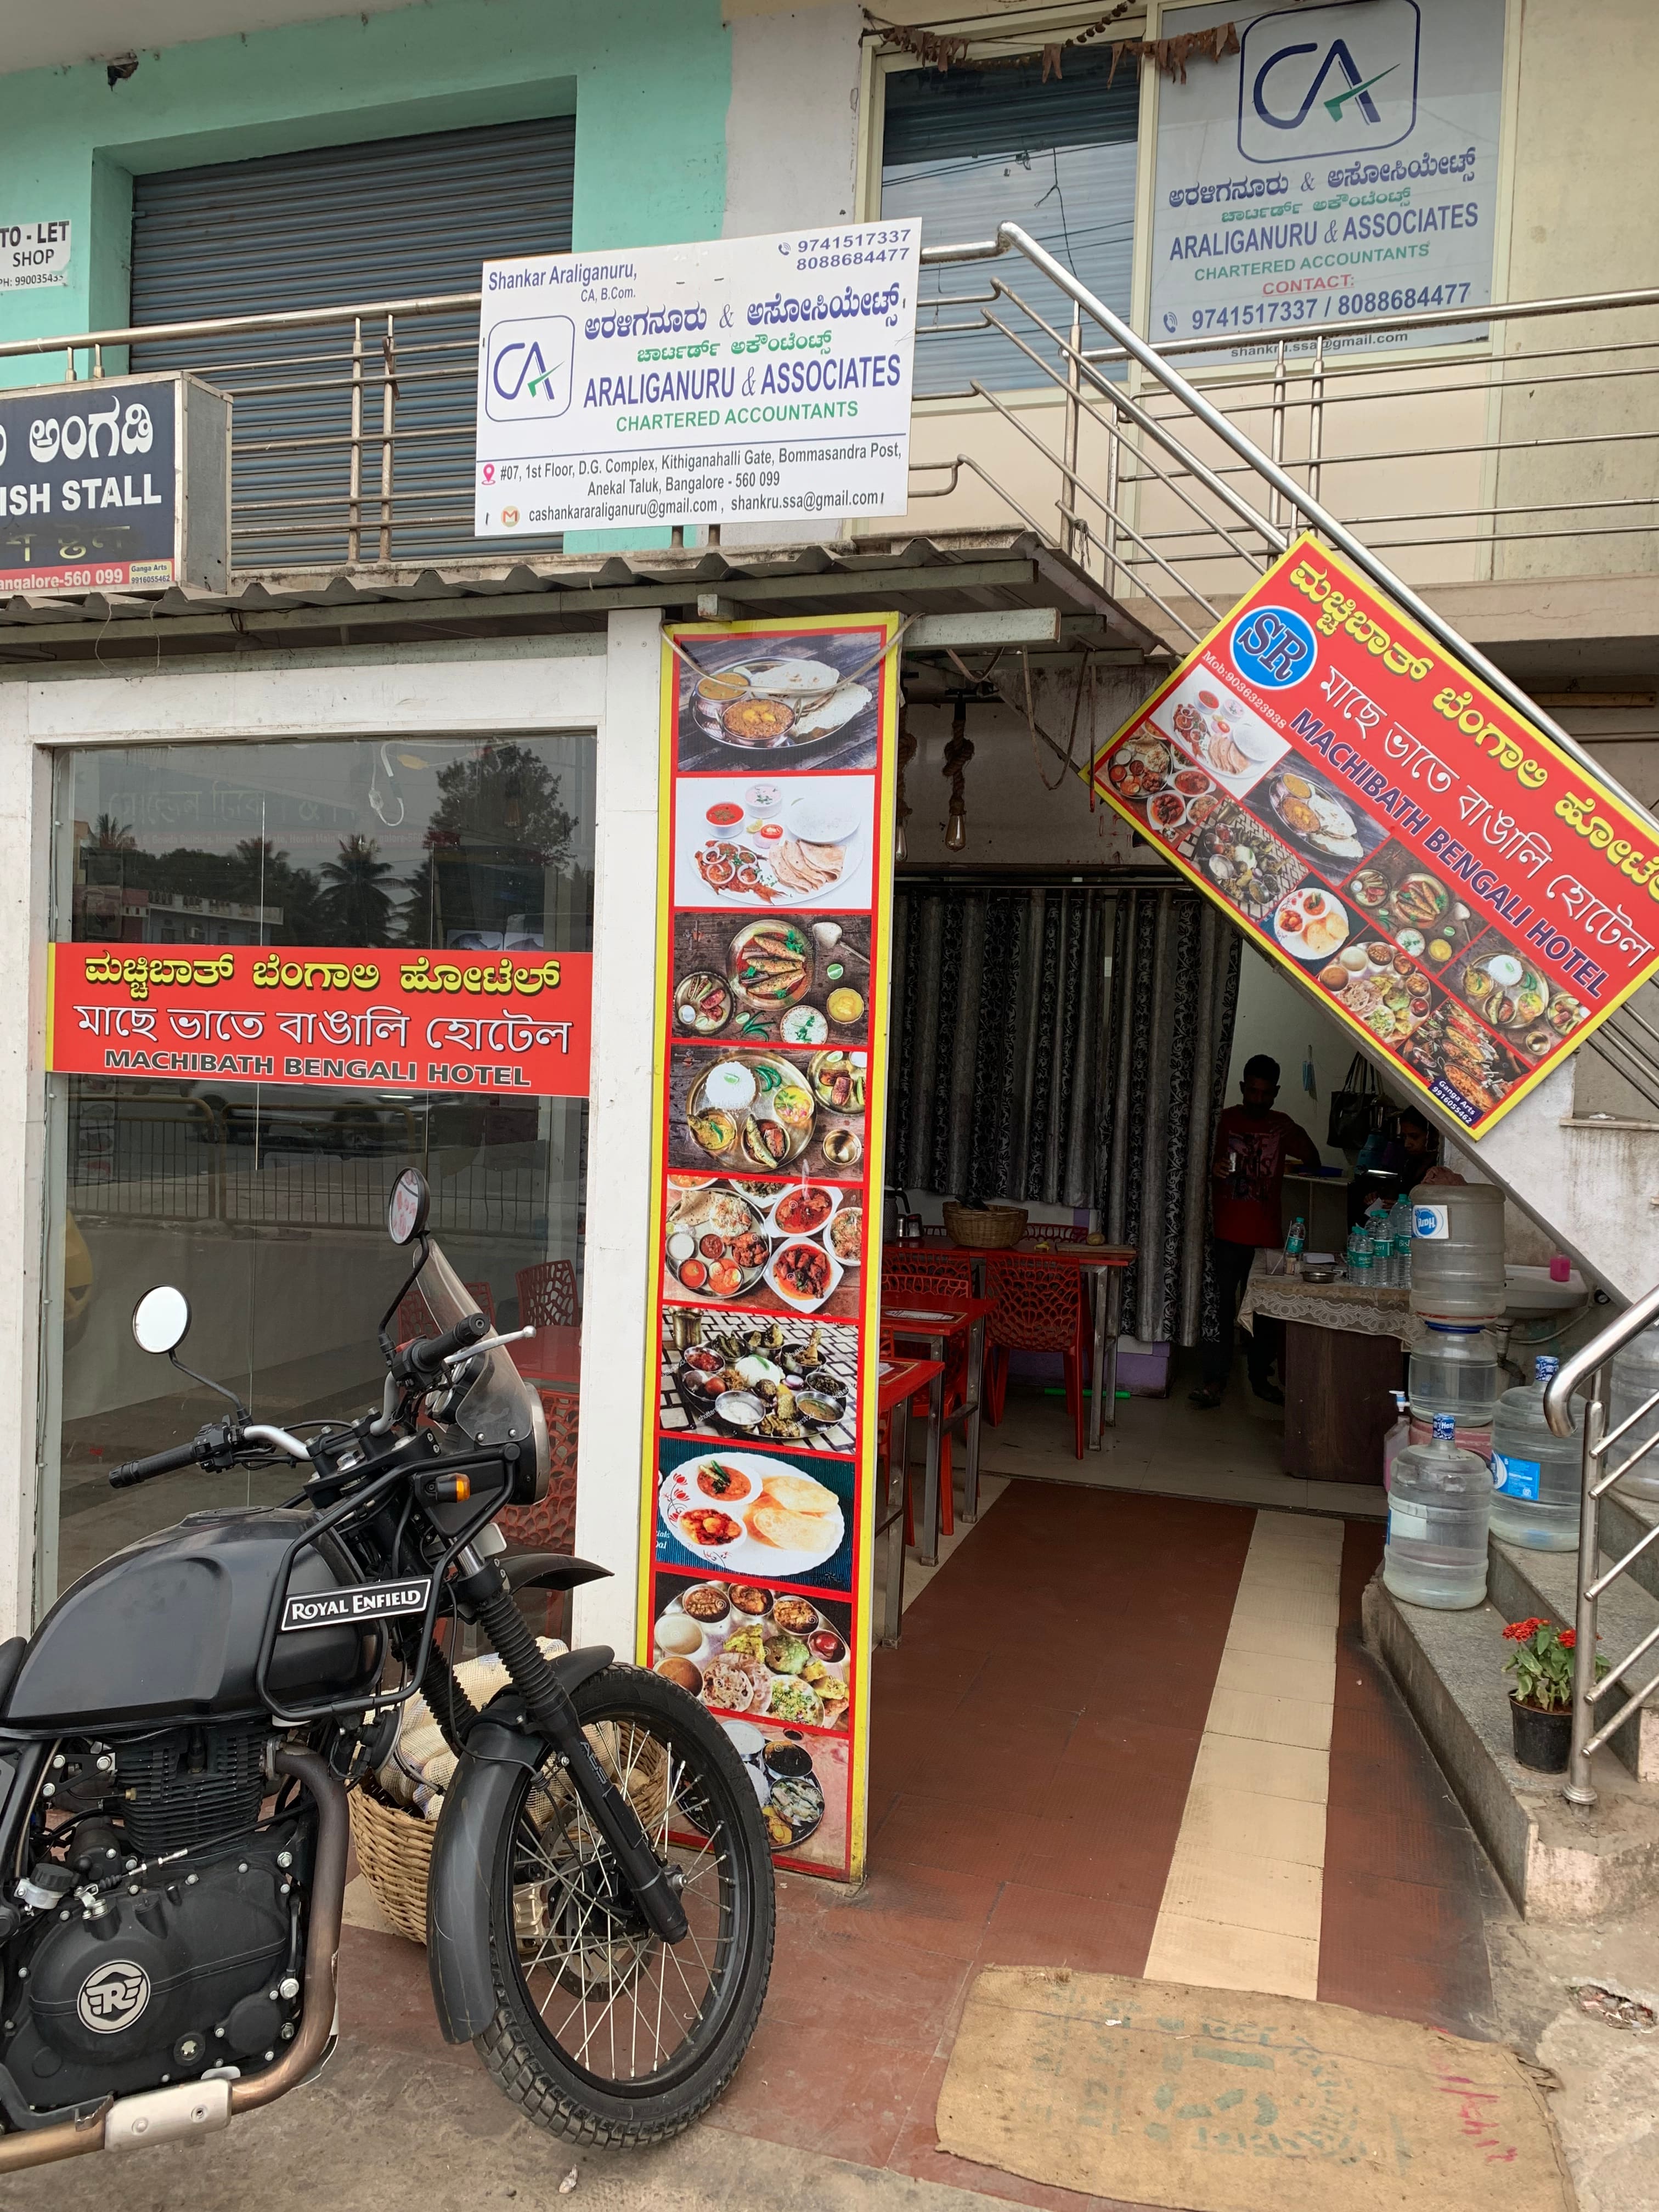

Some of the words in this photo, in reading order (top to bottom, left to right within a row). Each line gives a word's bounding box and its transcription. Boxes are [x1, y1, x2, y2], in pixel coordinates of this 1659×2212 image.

[1169, 171, 1289, 207] ಅರಳಿಗನೂರು
[1301, 172, 1316, 193] &
[1328, 147, 1476, 189] ಅಸೋಸಿಯೇಟ್ಸ್
[0, 226, 21, 247] TO
[37, 221, 70, 244] LET
[798, 229, 911, 253] 9741517337
[1170, 221, 1317, 261] ARALIGANURU
[1324, 219, 1338, 244] &
[1342, 202, 1479, 242] ASSOCIATES
[13, 249, 55, 267] SHOP
[797, 247, 910, 270] 8088684477
[1194, 258, 1296, 281] CHARTERED
[1300, 244, 1429, 269] ACCOUNTANTS
[488, 269, 546, 291] Shankar
[549, 263, 637, 286] Araliganuru,
[581, 290, 597, 303] CA,
[601, 286, 636, 301] B.Com.
[1262, 274, 1355, 296] CONTACT:
[585, 300, 707, 340] ಅರಳಿಗನೂರು
[719, 303, 734, 329] &
[747, 281, 900, 327] ಅಸೋಸಿಯೇಟ್ಸ್
[1192, 298, 1317, 330] 9741517337
[1339, 283, 1471, 315] 8088684477
[731, 330, 832, 355] ಅಕೌಂಟೆಂಟ್ಸ್
[583, 366, 735, 408] ARALIGANURU
[742, 366, 757, 397] &
[760, 354, 901, 395] ASSOCIATES
[29, 396, 154, 463] ಅಂಗಡಿ
[616, 409, 720, 432] CHARTERED
[725, 400, 859, 425] ACCOUNTANTS
[500, 465, 522, 482] #07,
[526, 463, 541, 479] 1st
[545, 461, 575, 478] Floor,
[579, 459, 602, 475] D.G.
[606, 456, 658, 476] Complex,
[662, 450, 741, 472] Kithiganahalli
[744, 449, 775, 466] Gate,
[779, 443, 866, 463] Bommasandra
[871, 442, 901, 459] Post,
[61, 473, 162, 511] STALL
[588, 479, 625, 496] Anekal
[629, 477, 662, 494] Taluk,
[665, 474, 724, 494] Bangalore
[735, 472, 755, 488] 560
[759, 471, 780, 486] 099
[529, 497, 718, 522] cashankararaliganuru@gmail.com
[731, 489, 878, 511] shankru.ssa@gmail.com
[95, 568, 123, 585] 099
[131, 565, 151, 573] Ganga
[131, 574, 170, 584] 9916055462
[1236, 612, 1308, 681] SR
[1432, 687, 1548, 790] ಬೆಂಗಾಲಿ
[1320, 665, 1388, 740] মাছে
[1384, 721, 1460, 792] ভাতে
[1458, 785, 1554, 879] বাঙালি
[1546, 874, 1655, 968] হোটেল
[1289, 708, 1432, 836] MACHIBATH
[1423, 826, 1534, 928] BENGALI
[1525, 918, 1610, 999] HOTEL
[252, 952, 380, 989] ಬೆಂಗಾಲಿ
[399, 956, 561, 995] ಹೋಟೆಲ್
[72, 1005, 158, 1042] মাছে
[167, 1008, 266, 1041] ভাতে
[275, 1005, 411, 1047] বাঙালি
[426, 1008, 573, 1054] হোটেল
[104, 1048, 274, 1075] MACHIBATH
[283, 1057, 417, 1082] BENGALI
[427, 1062, 532, 1087] HOTEL
[1432, 1086, 1472, 1124] 9916055462
[1439, 1080, 1461, 1102] Ganga
[1460, 1101, 1476, 1115] Arts
[291, 1599, 349, 1620] ROYAL
[352, 1590, 421, 1614] ENFIELD
